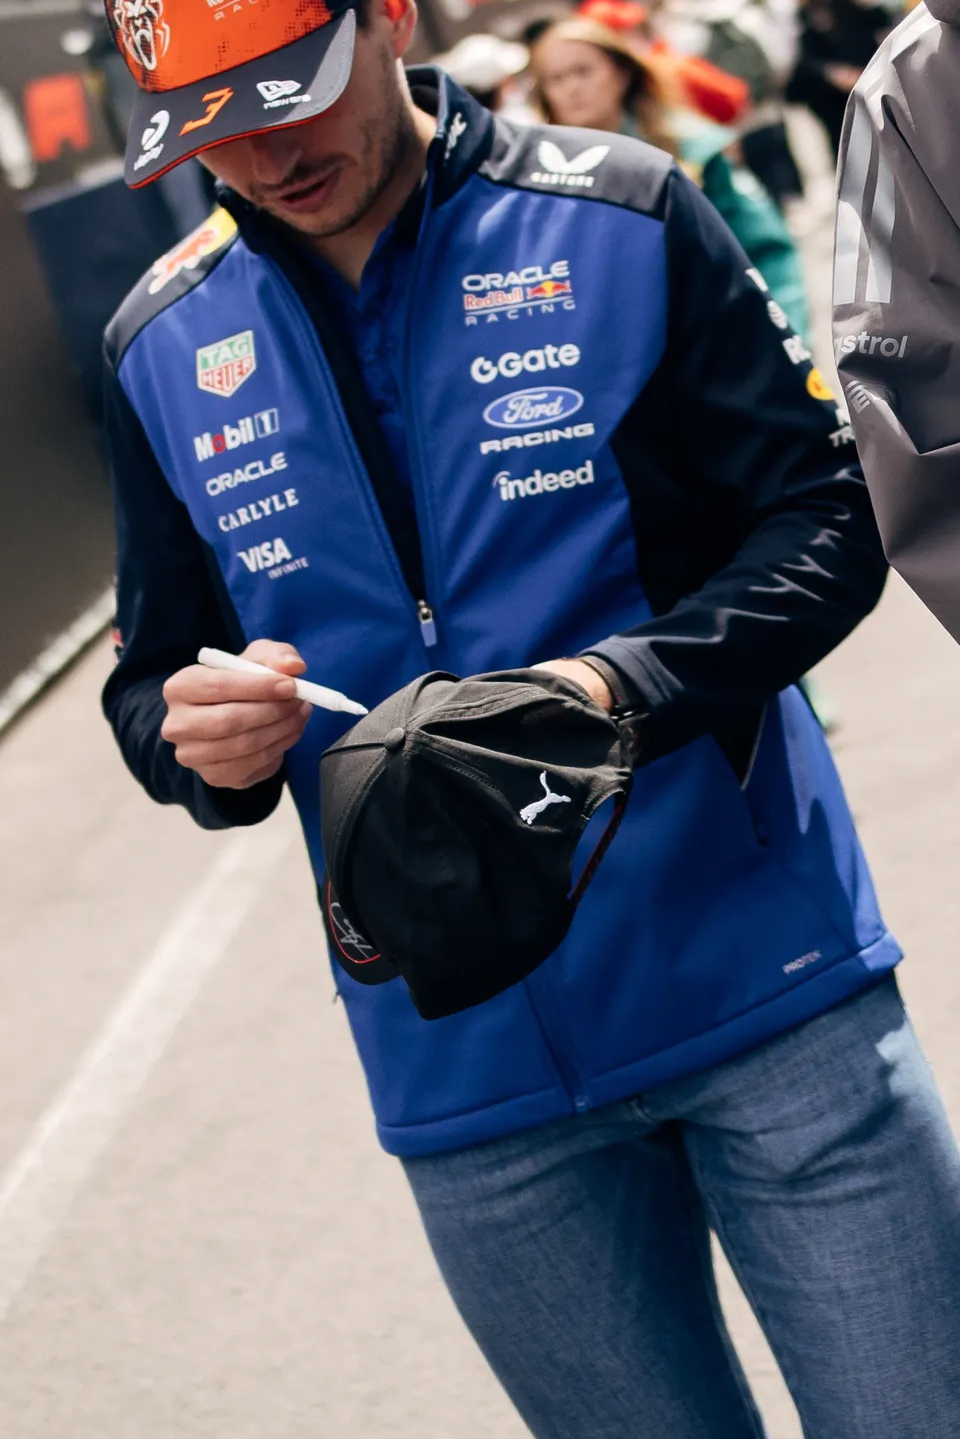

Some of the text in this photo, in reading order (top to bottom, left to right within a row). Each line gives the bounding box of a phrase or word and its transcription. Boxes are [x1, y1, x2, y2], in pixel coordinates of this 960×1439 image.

[180, 86, 235, 137] 3
[462, 260, 571, 291] ORACLE
[465, 299, 577, 327] RACING
[202, 337, 251, 369] TAG
[497, 343, 581, 378] Gate
[201, 357, 254, 391] HEUER
[502, 392, 565, 424] Ford
[193, 416, 256, 462] Mobil
[480, 423, 595, 454] RACING
[205, 451, 289, 496] ORACLE
[495, 459, 595, 501] indeed
[217, 487, 300, 533] CARLYLE
[236, 537, 293, 573] VISA
